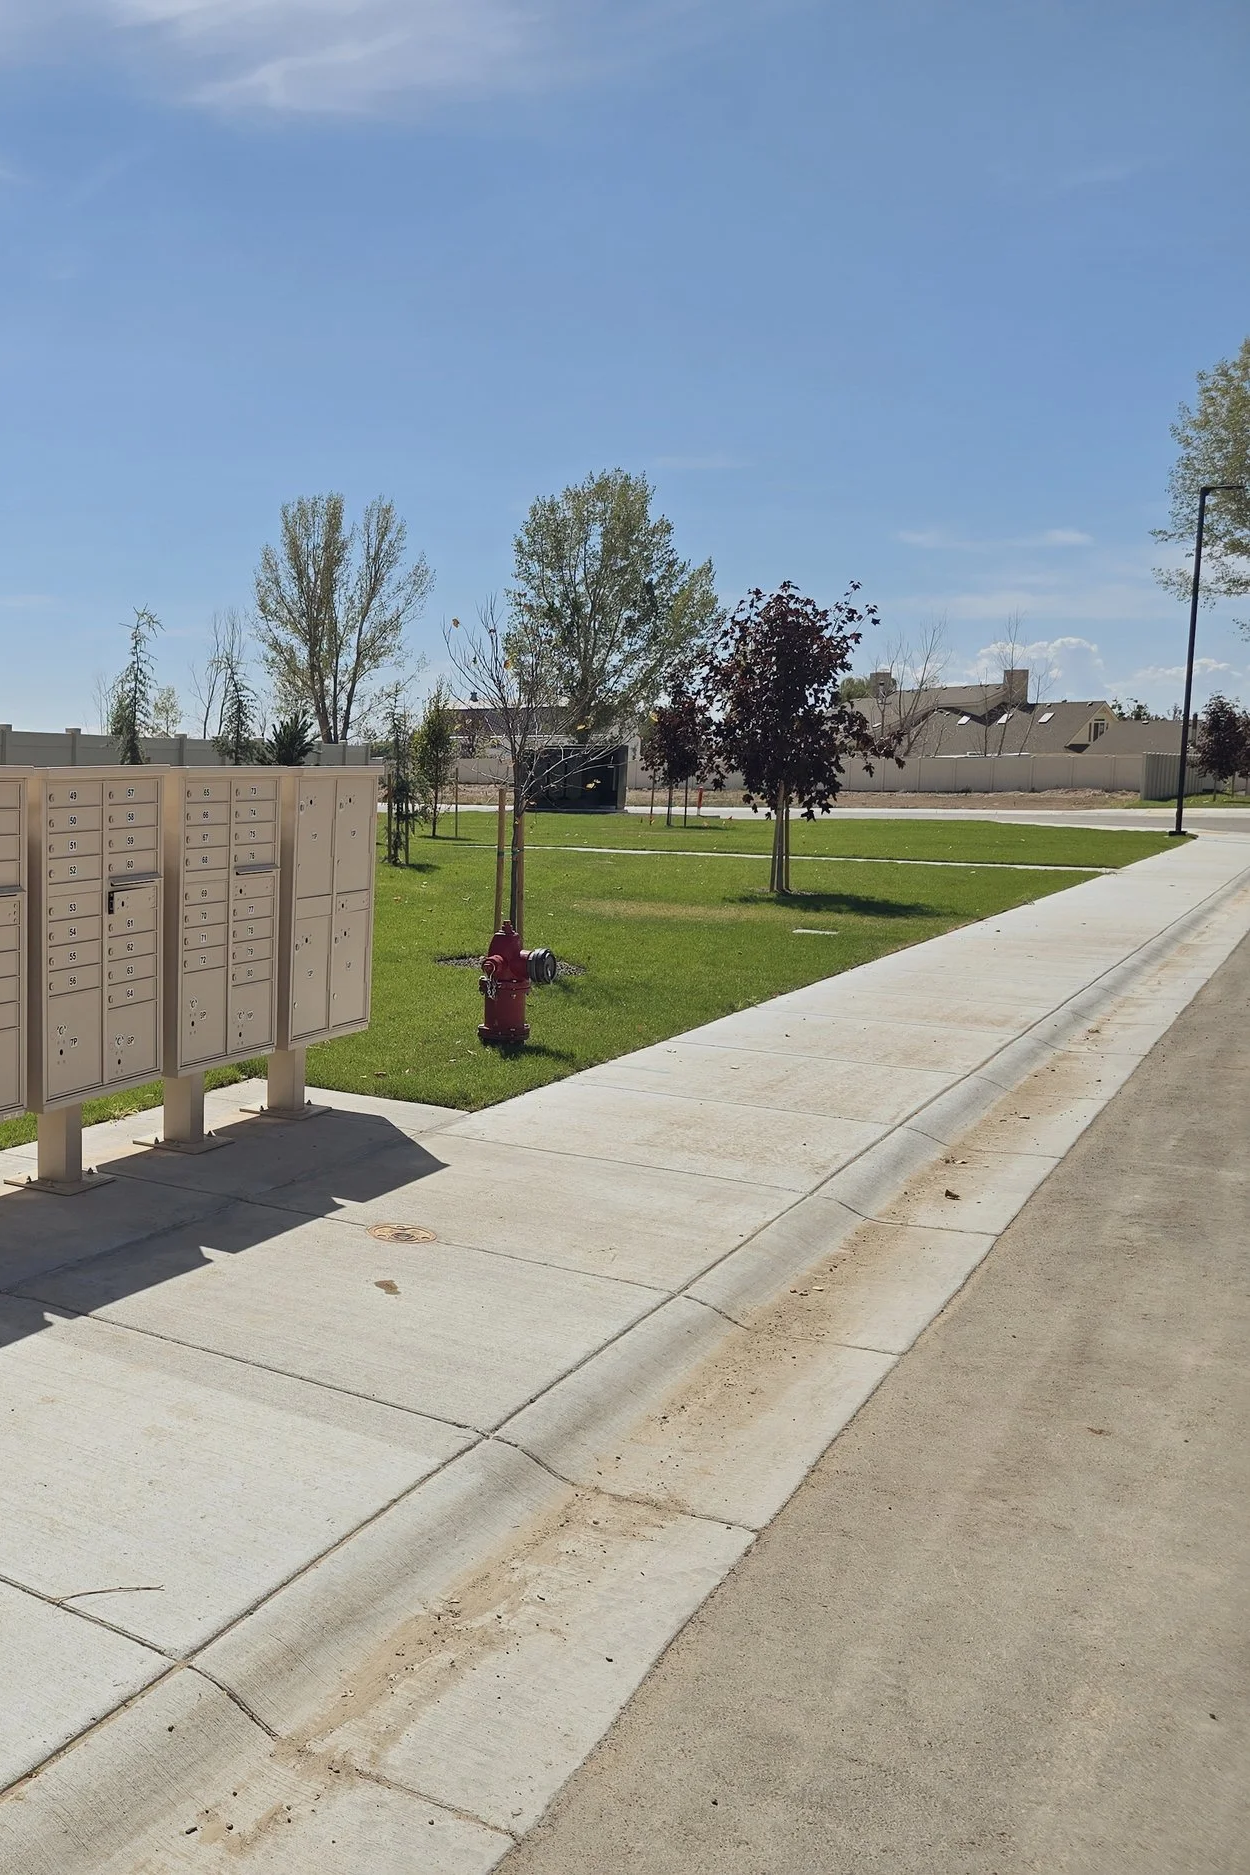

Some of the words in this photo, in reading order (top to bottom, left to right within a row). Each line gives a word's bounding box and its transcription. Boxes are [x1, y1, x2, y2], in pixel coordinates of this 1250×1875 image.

[127, 788, 135, 797] 57
[69, 816, 77, 825] 50
[127, 812, 135, 821] 58
[69, 841, 77, 850] 51
[69, 865, 77, 875] 52
[69, 903, 77, 912] 53
[69, 927, 77, 937] 54
[69, 951, 77, 961] 55
[69, 976, 77, 986] 56
[126, 989, 134, 998] 64
[69, 1037, 78, 1046] 7P
